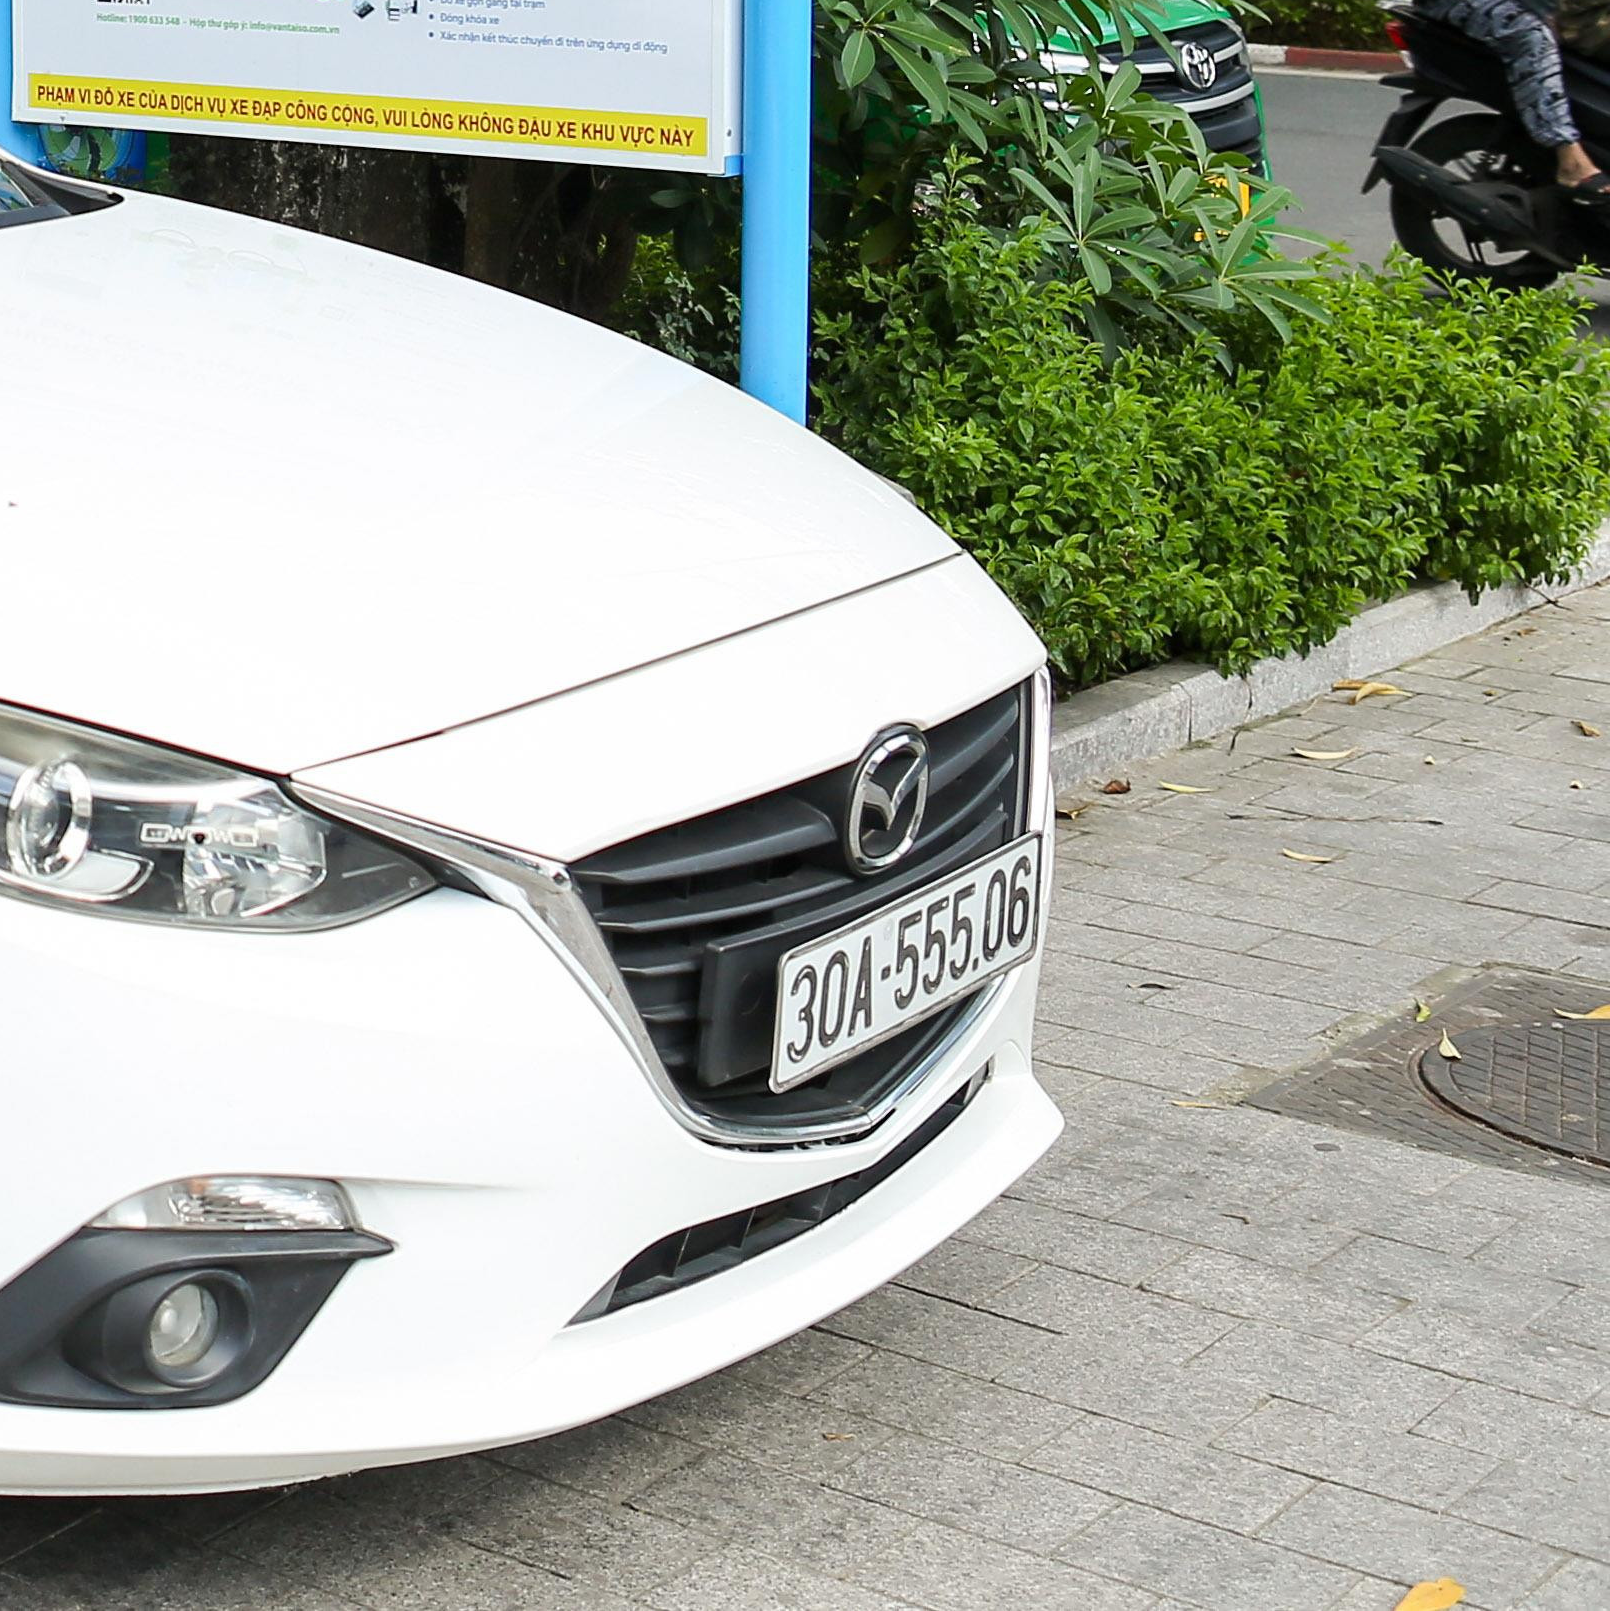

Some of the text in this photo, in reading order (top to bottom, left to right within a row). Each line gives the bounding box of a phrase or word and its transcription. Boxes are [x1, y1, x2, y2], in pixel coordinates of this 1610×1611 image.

[38, 86, 694, 147] PHẠM VI ĐỖ XE CỦA DỊCH VỤ XE ĐẠP CÔNG CỘNG, VUI LÒNG KHÔNG ĐẬU XE KHU VỰC NÀY
[788, 856, 1031, 1063] 30A-555.06
